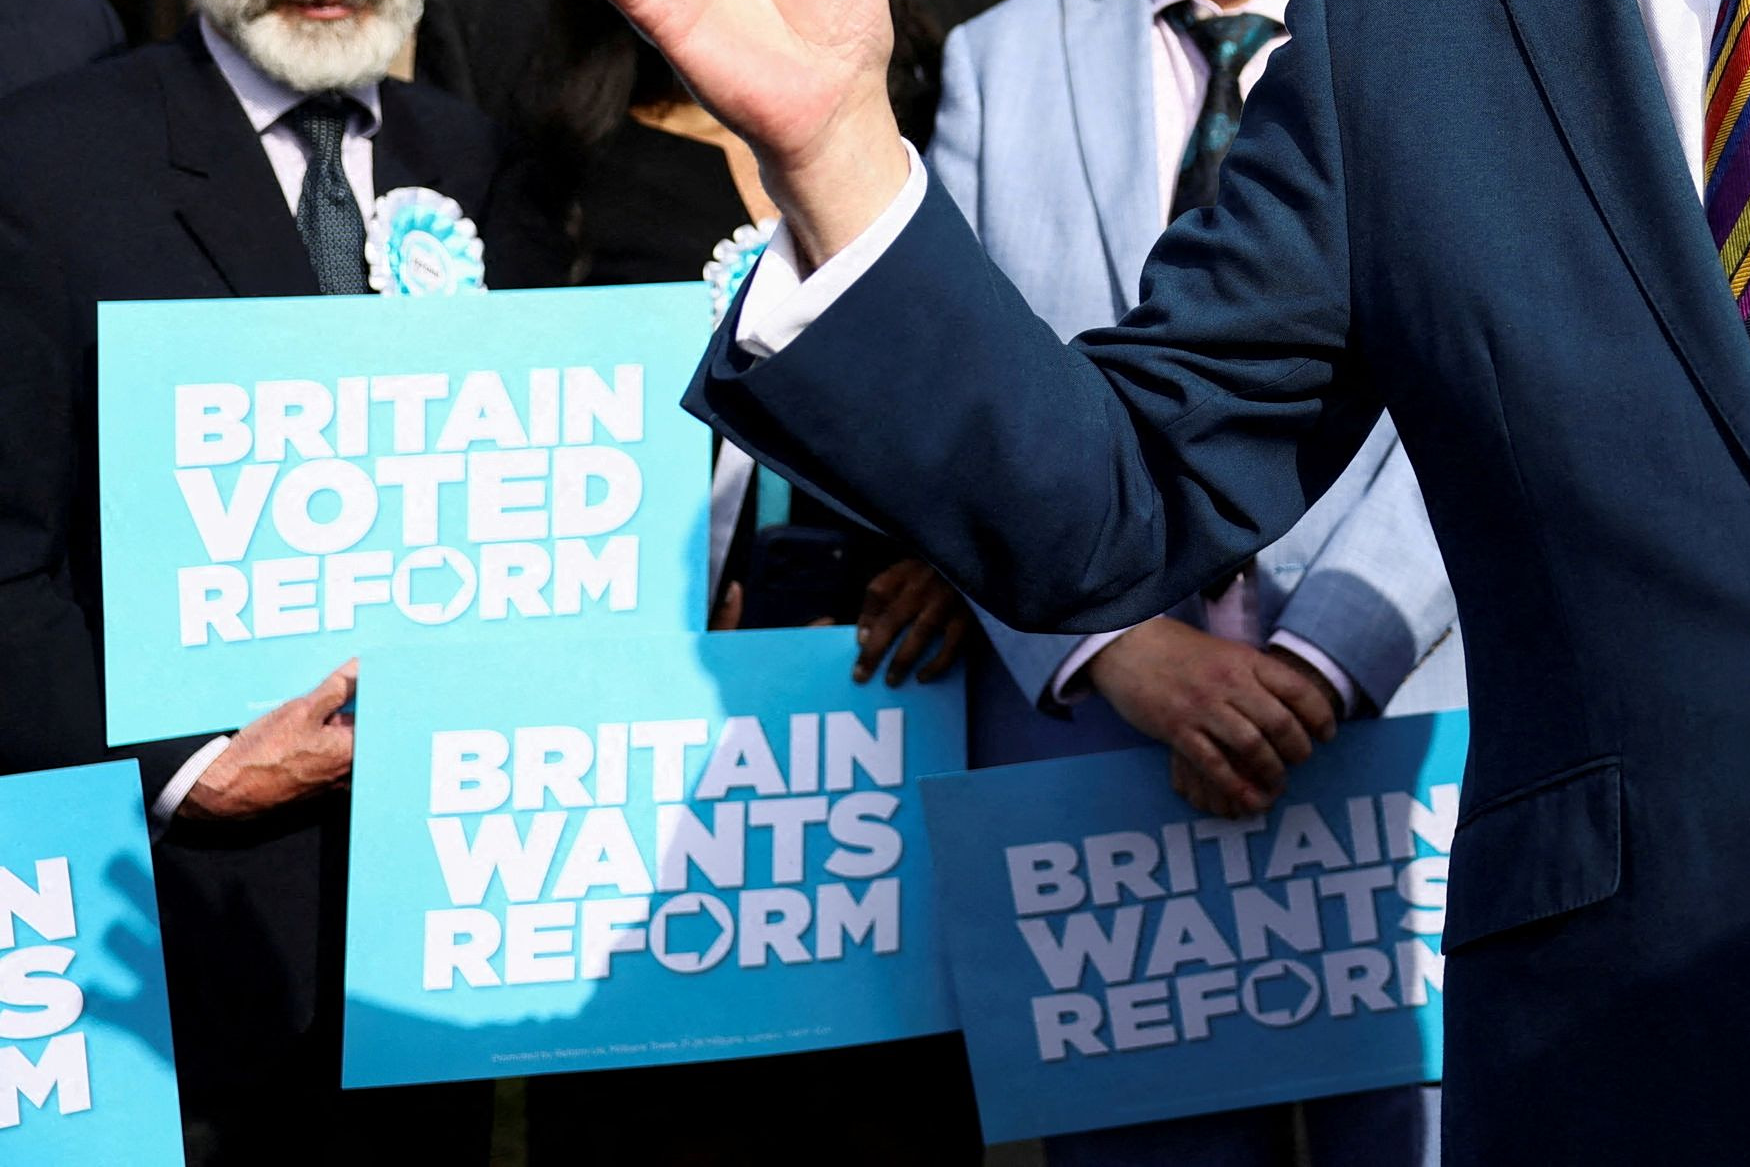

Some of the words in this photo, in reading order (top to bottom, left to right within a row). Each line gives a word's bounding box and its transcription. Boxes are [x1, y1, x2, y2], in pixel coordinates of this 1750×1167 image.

[174, 364, 644, 468] BRITAIN
[173, 445, 643, 562] VOTED
[177, 535, 640, 647] REFORM
[429, 707, 904, 815] BRITAIN
[426, 791, 903, 906] WANTS
[1005, 783, 1460, 916] BRITAIN
[422, 877, 901, 991] REFORM
[1015, 854, 1450, 991] WANTS
